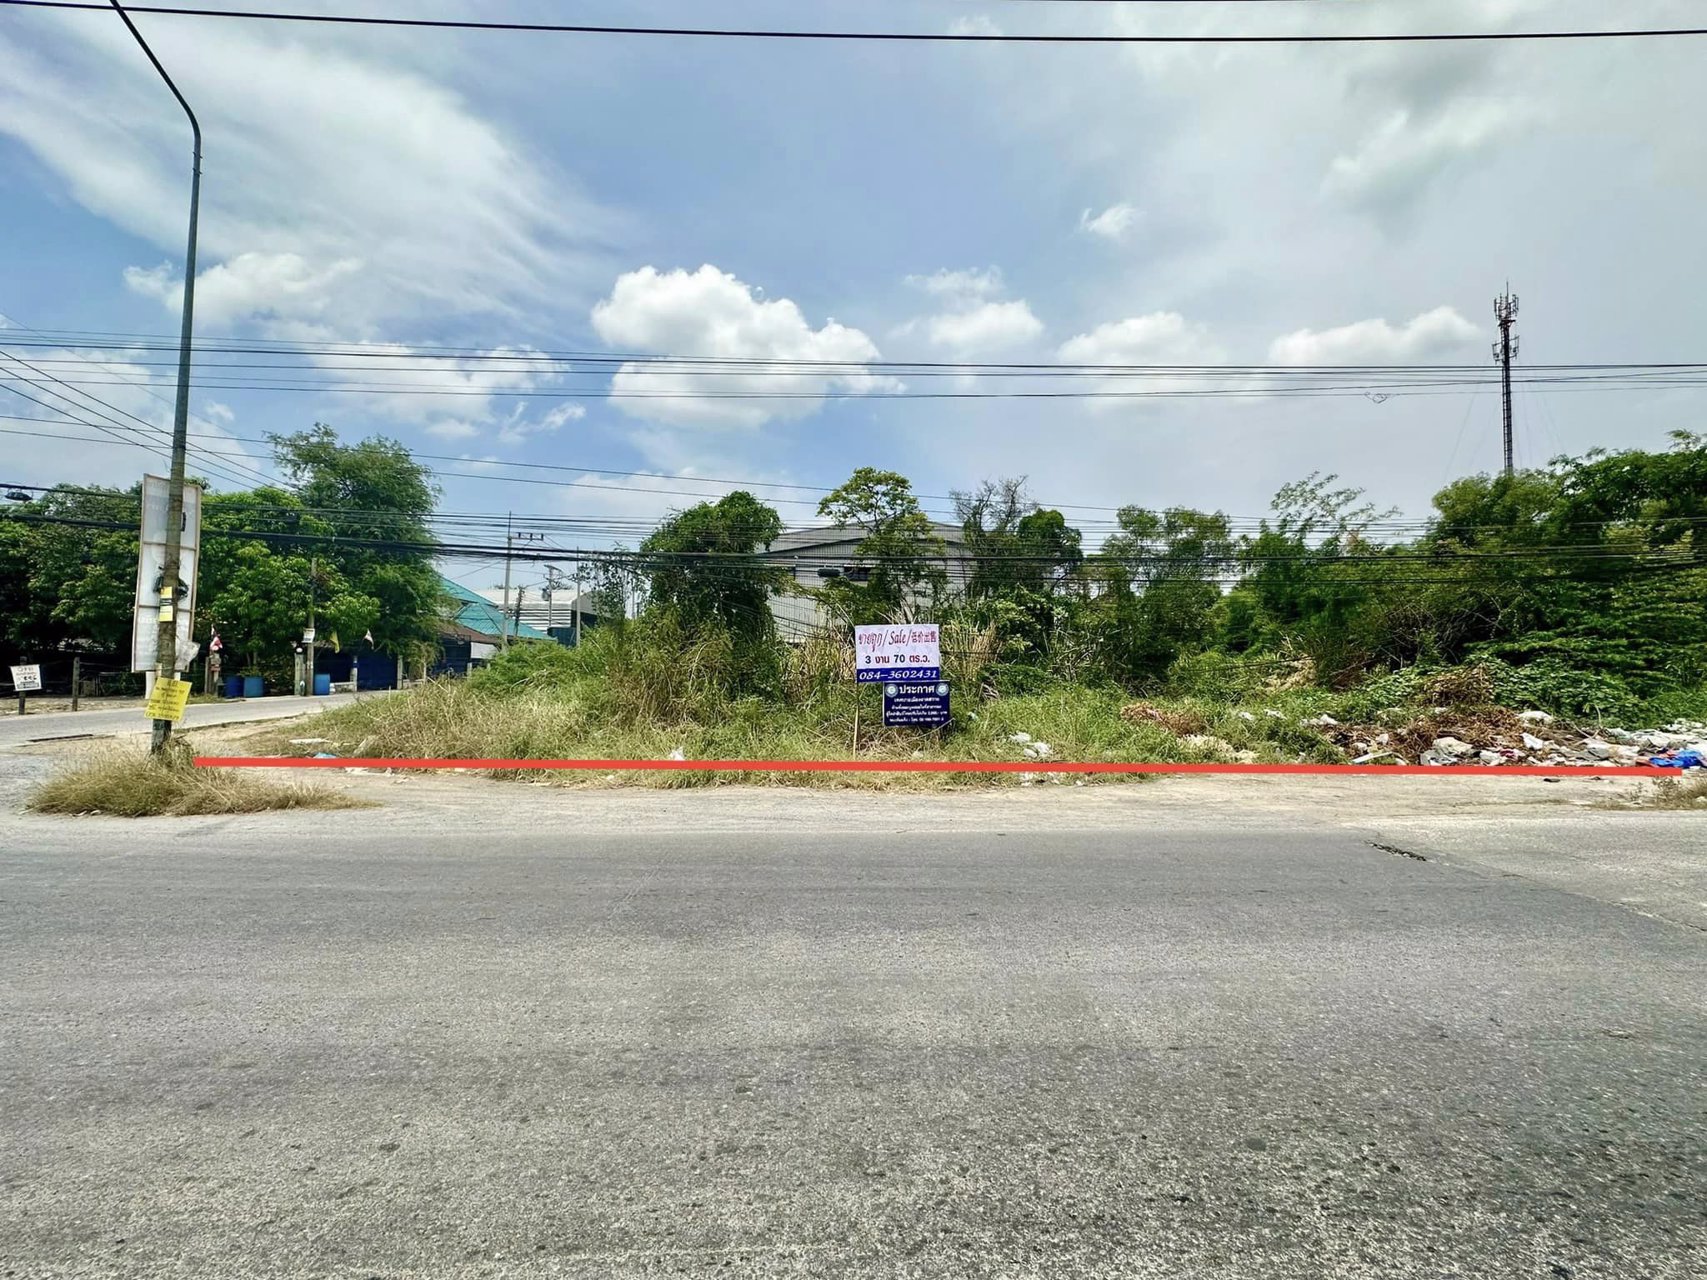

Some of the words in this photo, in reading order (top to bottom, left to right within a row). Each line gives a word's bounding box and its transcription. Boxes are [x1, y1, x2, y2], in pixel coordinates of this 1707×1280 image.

[865, 655, 871, 664] 3
[875, 655, 890, 664] งาน
[894, 654, 905, 663] 70
[859, 670, 937, 680] 084-3602431
[899, 684, 935, 694] ประกาศ
